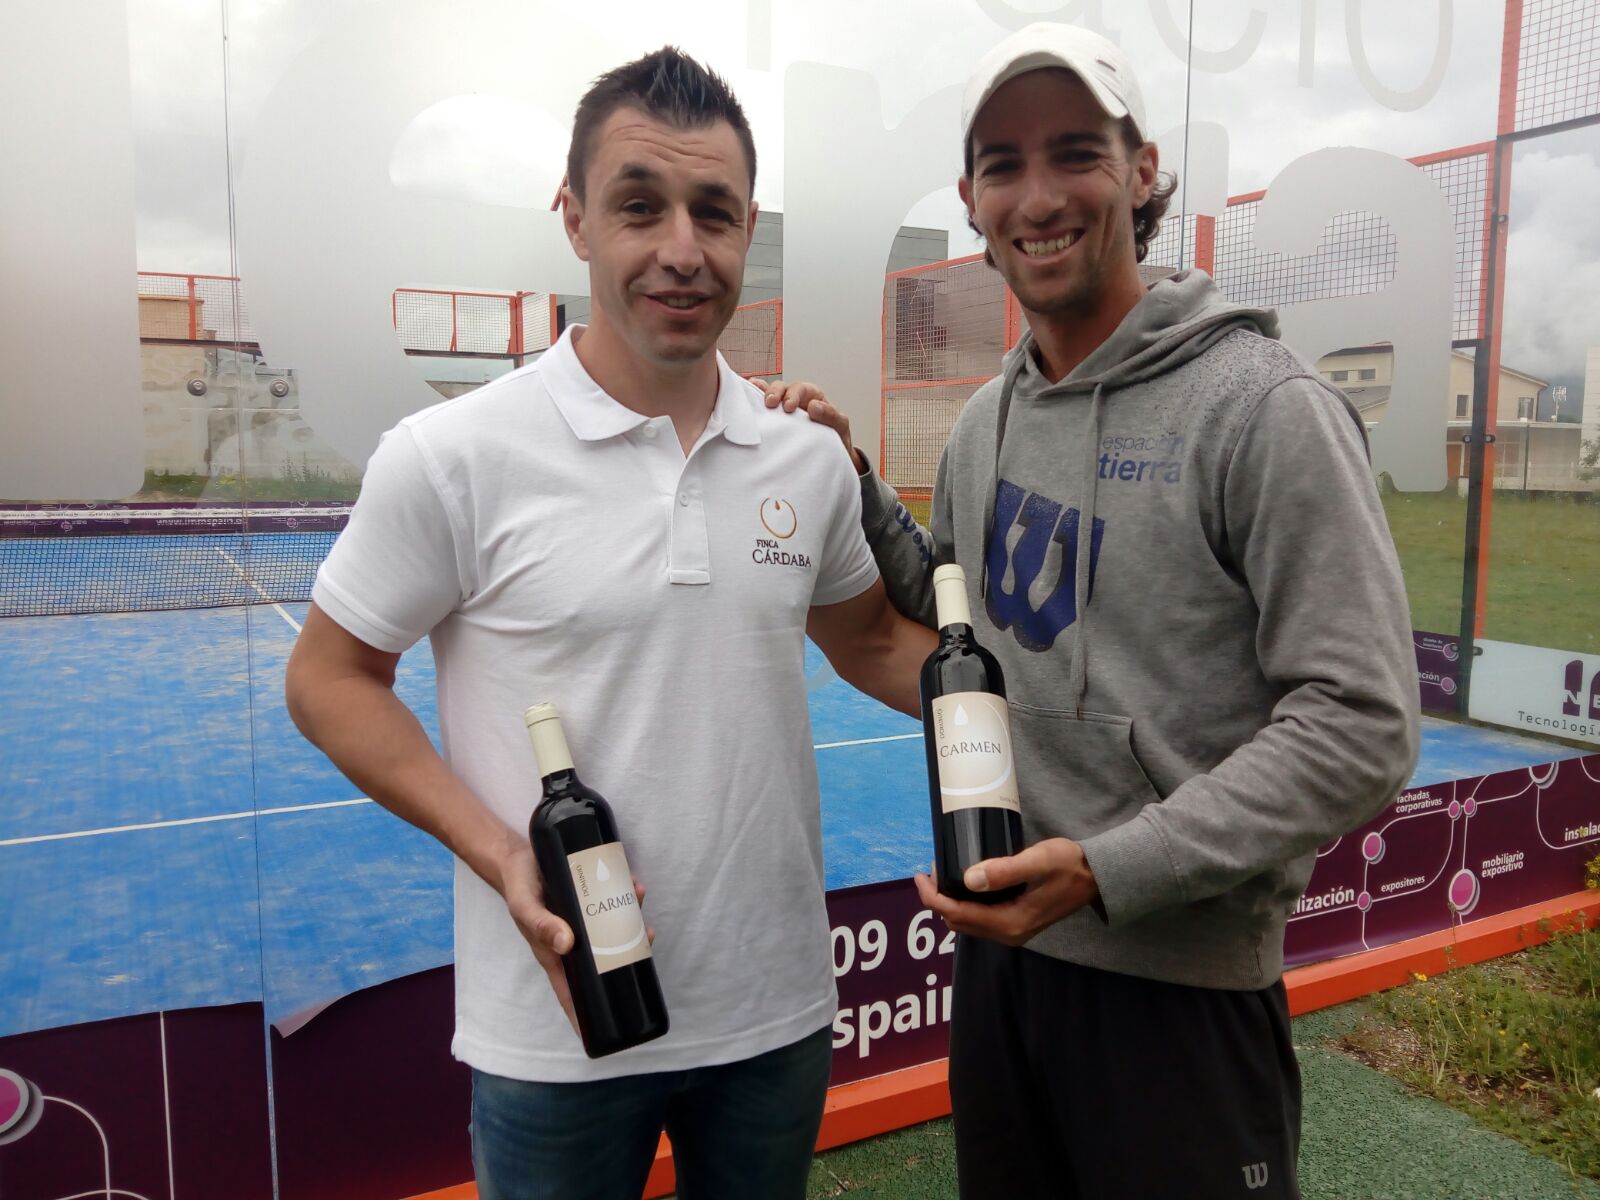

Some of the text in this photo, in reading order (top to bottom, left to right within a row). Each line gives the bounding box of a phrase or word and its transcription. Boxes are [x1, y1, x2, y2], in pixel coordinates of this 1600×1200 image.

[1098, 452, 1182, 483] tierra
[756, 539, 779, 549] FINCA
[752, 548, 812, 568] CÁRDABA
[1518, 710, 1600, 736] Tecnologí
[939, 740, 1002, 758] CARMEN
[1395, 798, 1443, 814] corporativas
[1481, 860, 1524, 878] expositivo
[1482, 850, 1525, 869] mobiliario
[1381, 875, 1426, 893] expositores
[1292, 885, 1355, 915] lización
[830, 919, 888, 978] 09
